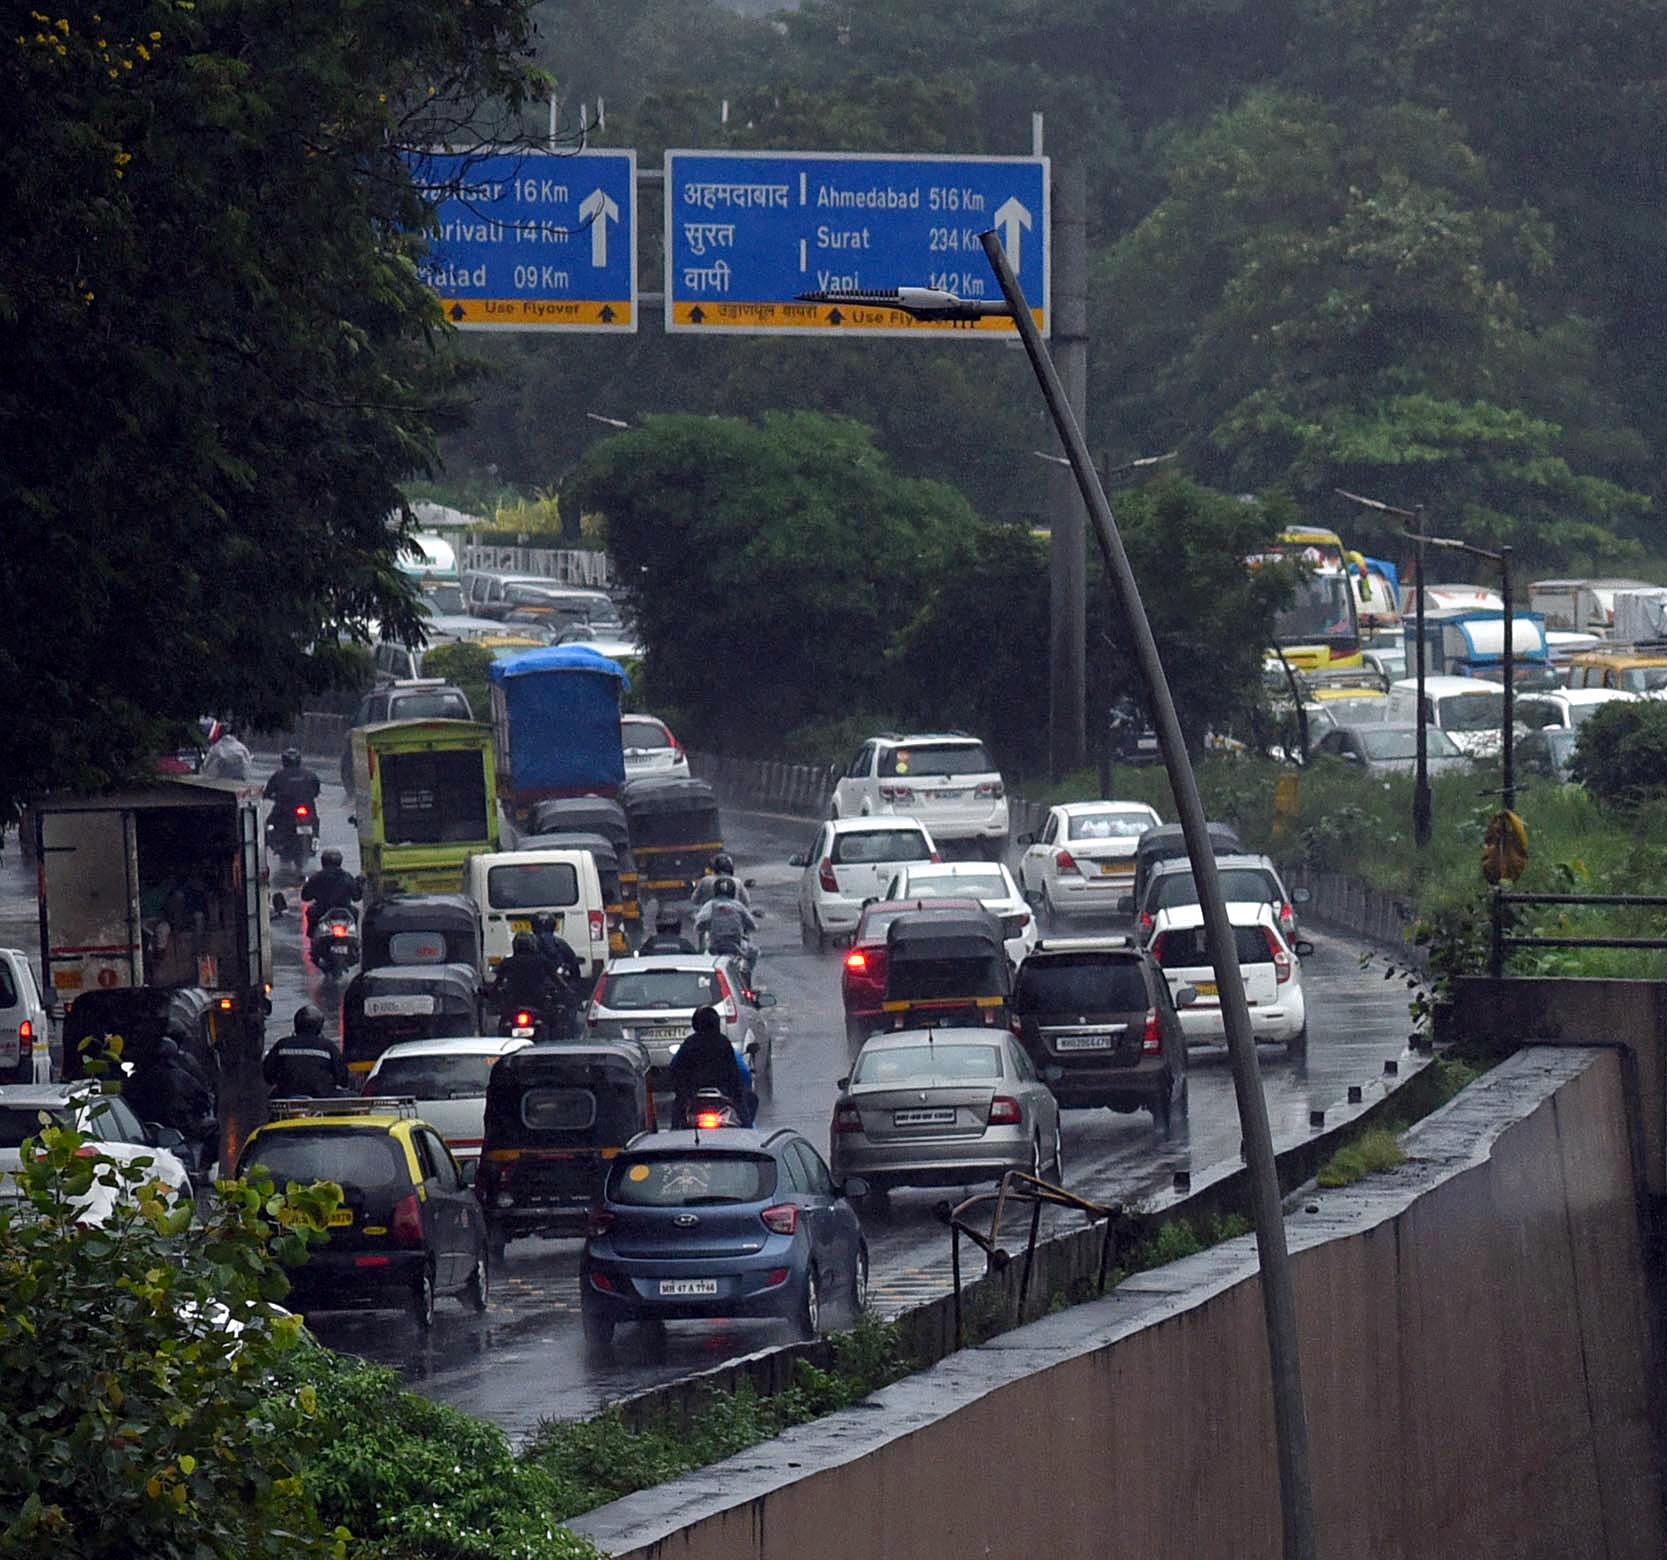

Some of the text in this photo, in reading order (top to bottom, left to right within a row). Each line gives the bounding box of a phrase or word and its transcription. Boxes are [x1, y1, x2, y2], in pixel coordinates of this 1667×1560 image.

[514, 180, 538, 201] 16
[542, 180, 569, 202] Km
[683, 183, 789, 208] अहमदाबाद
[816, 185, 984, 211] Ahmedabad 516 Km
[514, 219, 538, 243] 14
[542, 220, 569, 244] Km
[683, 222, 735, 255] सुरत
[816, 226, 870, 249] Surat
[929, 227, 959, 251] 234
[514, 265, 538, 289] 09
[542, 265, 569, 289] Km
[683, 259, 732, 292] वापी
[929, 271, 959, 296] 142
[962, 273, 984, 296] Km
[485, 302, 581, 318] Use Flyover
[852, 309, 883, 325] Use
